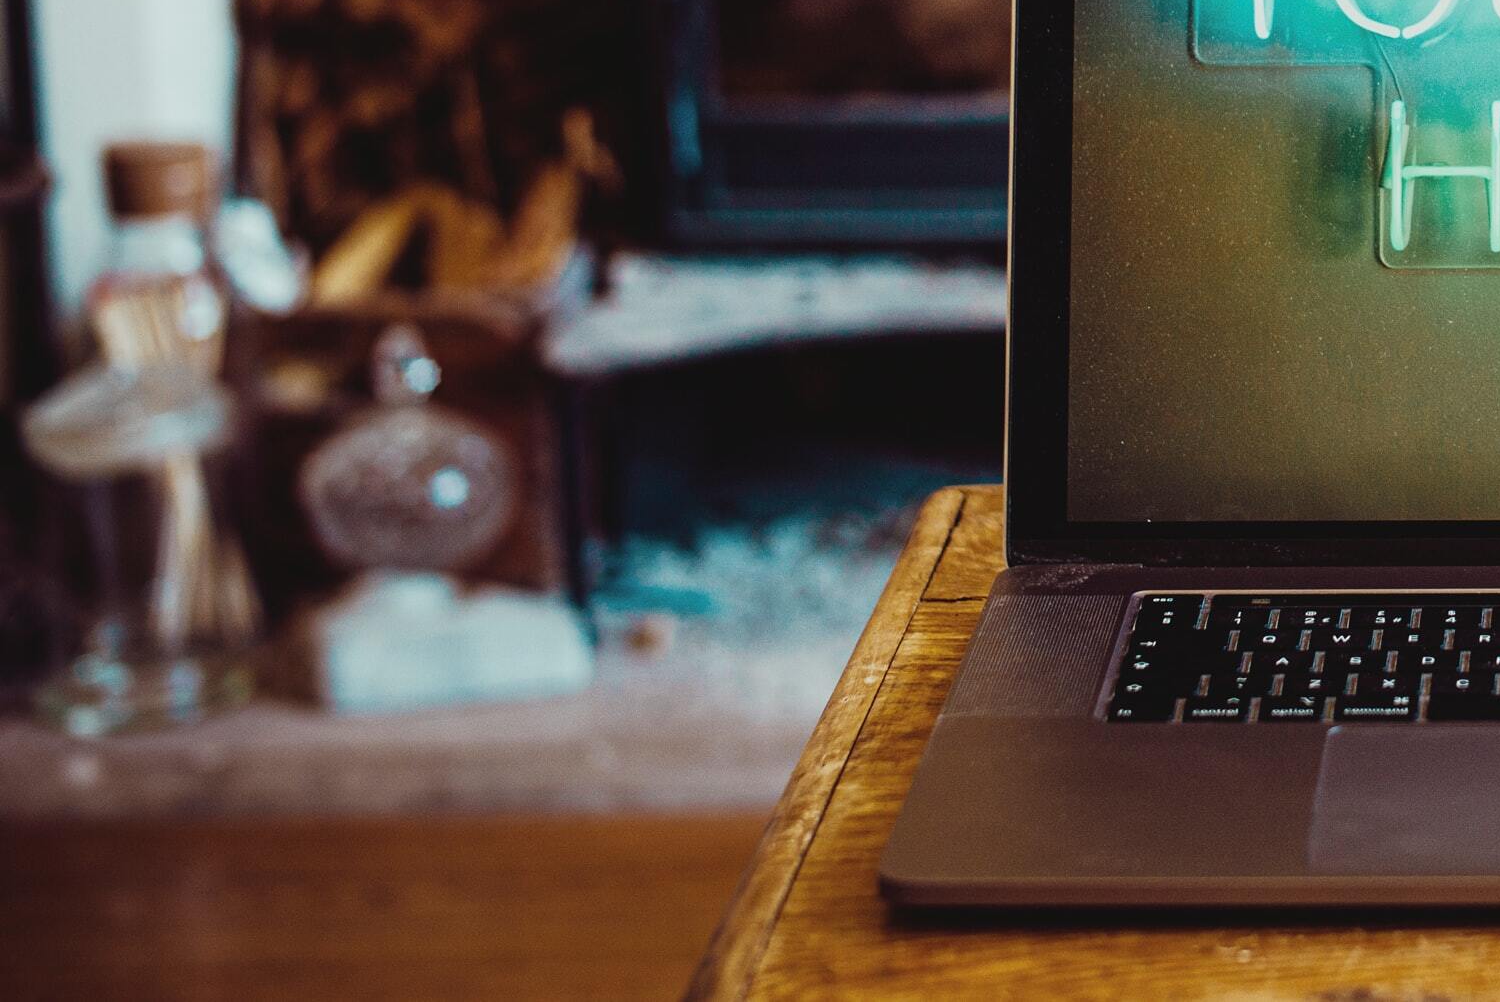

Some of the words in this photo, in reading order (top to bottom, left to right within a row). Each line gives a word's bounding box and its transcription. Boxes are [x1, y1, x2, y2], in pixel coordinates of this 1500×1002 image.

[1303, 617, 1315, 625] 2
[1375, 616, 1386, 624] 3
[1445, 616, 1457, 624] 4
[1262, 635, 1277, 644] Q
[1332, 634, 1351, 643] W
[1407, 634, 1419, 643] E
[1478, 634, 1491, 643] R
[1275, 656, 1289, 666] A
[1421, 656, 1436, 665] D
[1308, 678, 1322, 689] Z
[1382, 678, 1396, 689] X
[1455, 678, 1470, 689] C
